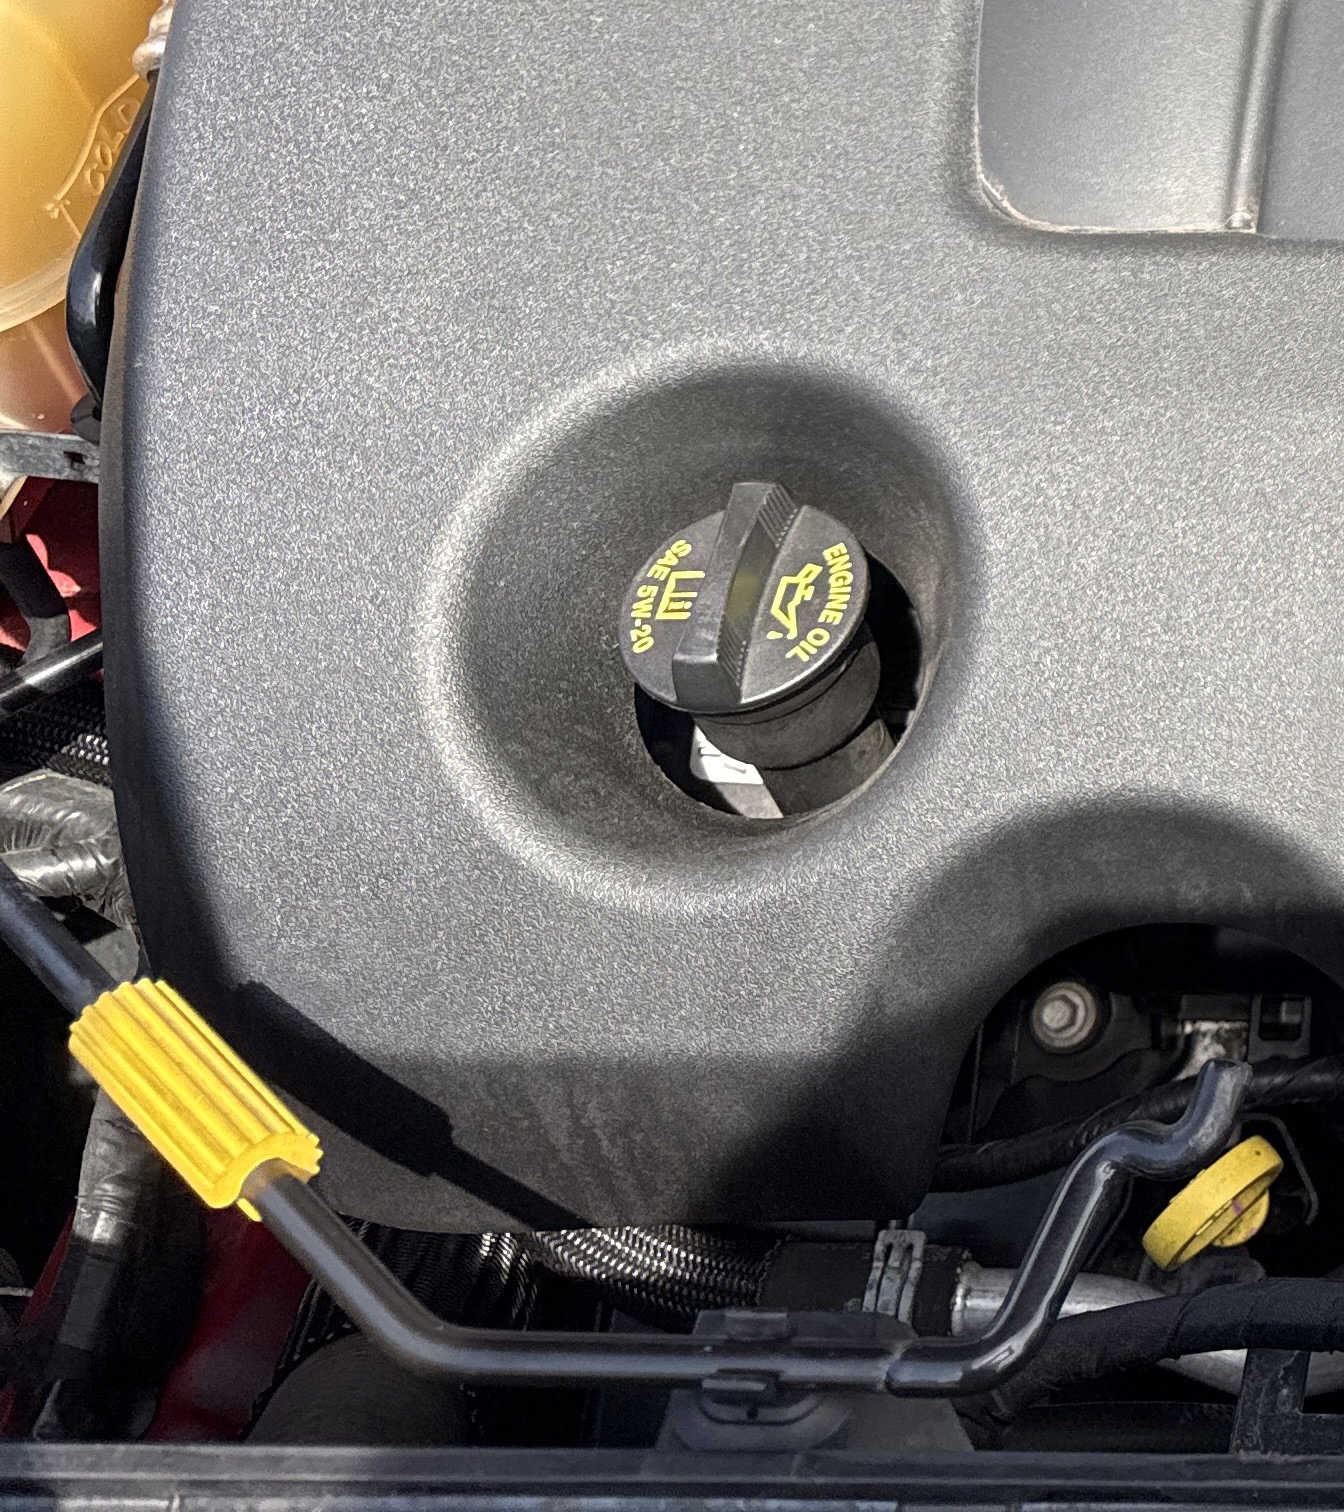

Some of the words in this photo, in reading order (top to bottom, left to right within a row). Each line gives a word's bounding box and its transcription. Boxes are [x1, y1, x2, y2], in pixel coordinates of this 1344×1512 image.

[647, 539, 692, 581] SAE
[818, 542, 855, 626] ENGINE
[630, 585, 658, 654] 5W-20
[785, 628, 832, 662] OIL
